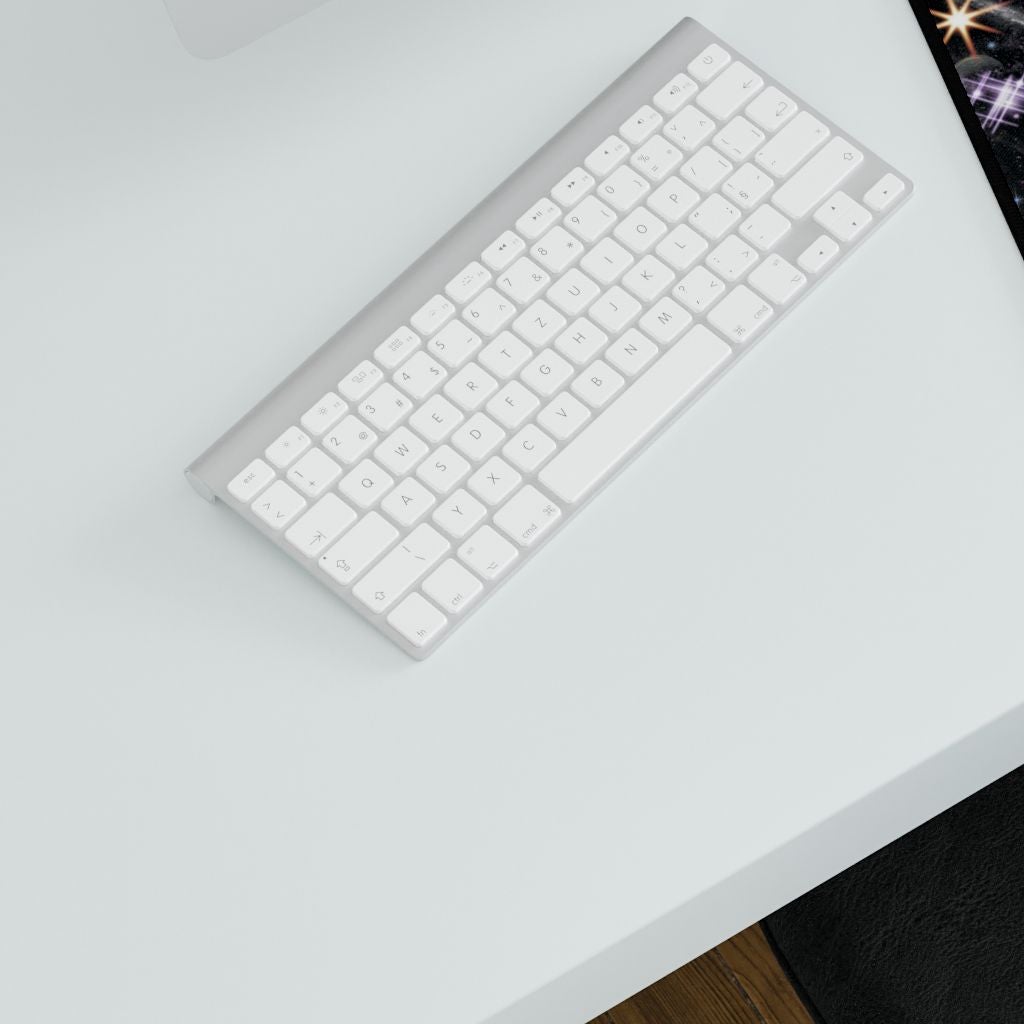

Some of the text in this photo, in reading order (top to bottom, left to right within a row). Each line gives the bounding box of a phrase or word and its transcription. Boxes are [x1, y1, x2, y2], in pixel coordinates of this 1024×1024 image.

[330, 437, 342, 447] 2
[365, 404, 376, 414] 3
[402, 371, 411, 381] 4
[435, 340, 446, 351] 5
[470, 309, 480, 319] 6
[503, 278, 512, 289] 7
[537, 247, 548, 257] 8
[571, 216, 580, 225] 9
[361, 478, 375, 489] Q
[394, 443, 409, 457] W
[431, 412, 444, 424] E
[465, 381, 478, 391] R
[500, 348, 512, 358] T
[534, 316, 548, 329] Z
[567, 285, 581, 297] U
[668, 193, 679, 204] P
[401, 495, 414, 507] A
[435, 461, 447, 472] S
[469, 429, 482, 441] D
[504, 396, 515, 407] F
[539, 364, 552, 375] G
[572, 332, 587, 344] H
[608, 301, 619, 312] J
[640, 270, 653, 281] K
[674, 241, 687, 249] L
[451, 505, 463, 516] Y
[486, 472, 501, 486] X
[522, 440, 535, 451] C
[556, 407, 567, 417] V
[590, 376, 603, 387] B
[623, 343, 638, 356] N
[657, 311, 673, 325] M
